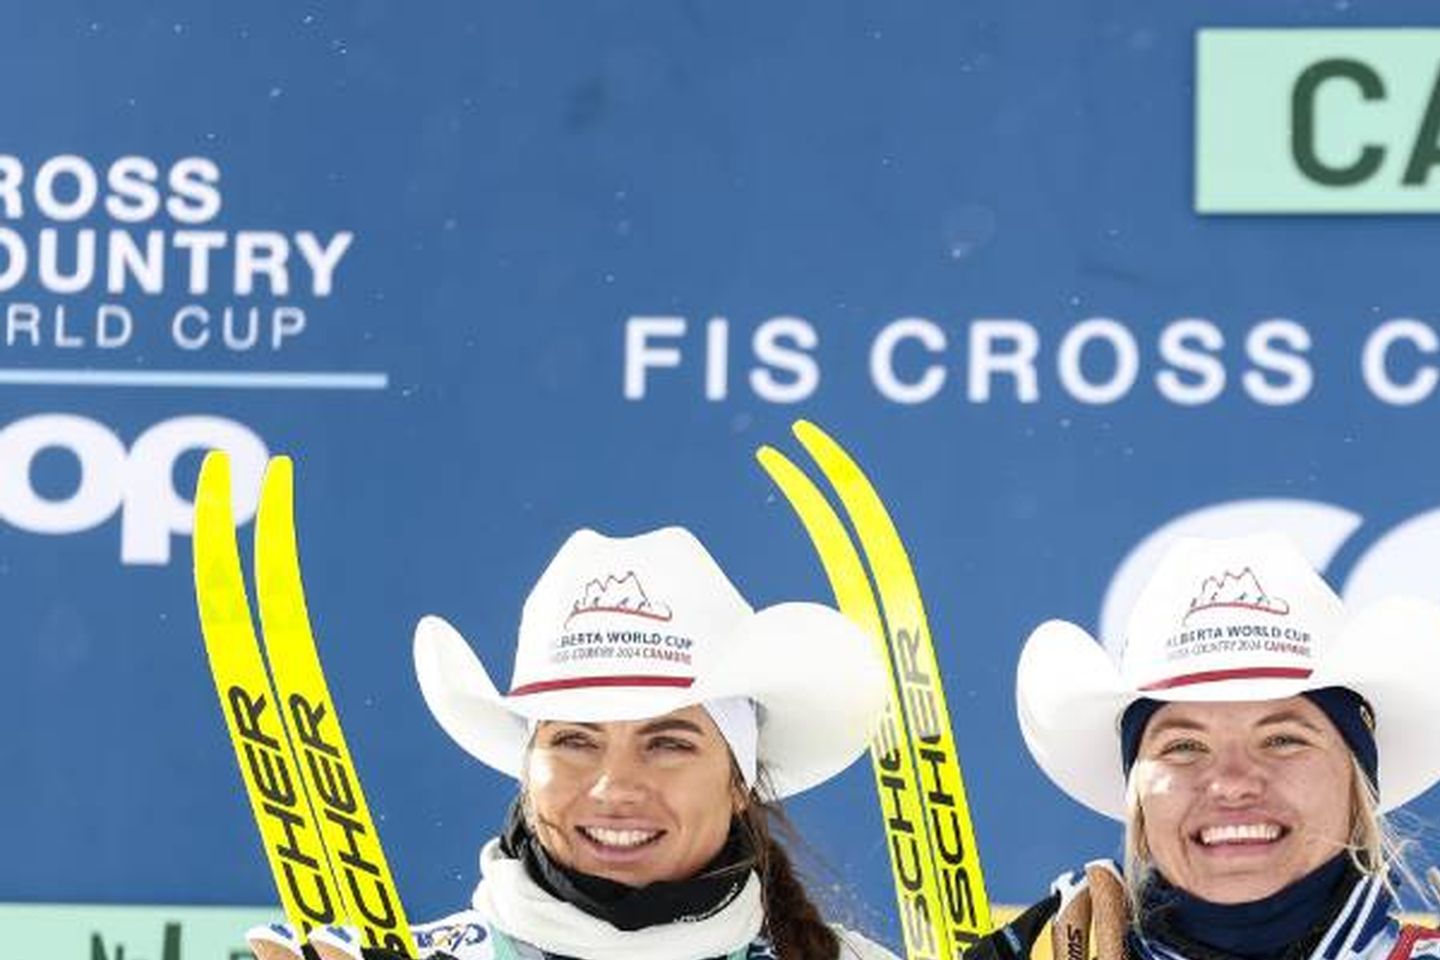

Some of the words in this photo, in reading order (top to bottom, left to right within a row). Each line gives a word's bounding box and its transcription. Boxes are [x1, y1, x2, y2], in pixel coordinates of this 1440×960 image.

[172, 305, 306, 350] CUP
[625, 316, 820, 403] FIS
[870, 318, 1314, 404] CROSS
[607, 631, 661, 646] WORLD
[665, 634, 693, 650] CUP
[1227, 624, 1281, 639] WORLD
[1284, 628, 1311, 643] CUP
[227, 685, 336, 932] CHER
